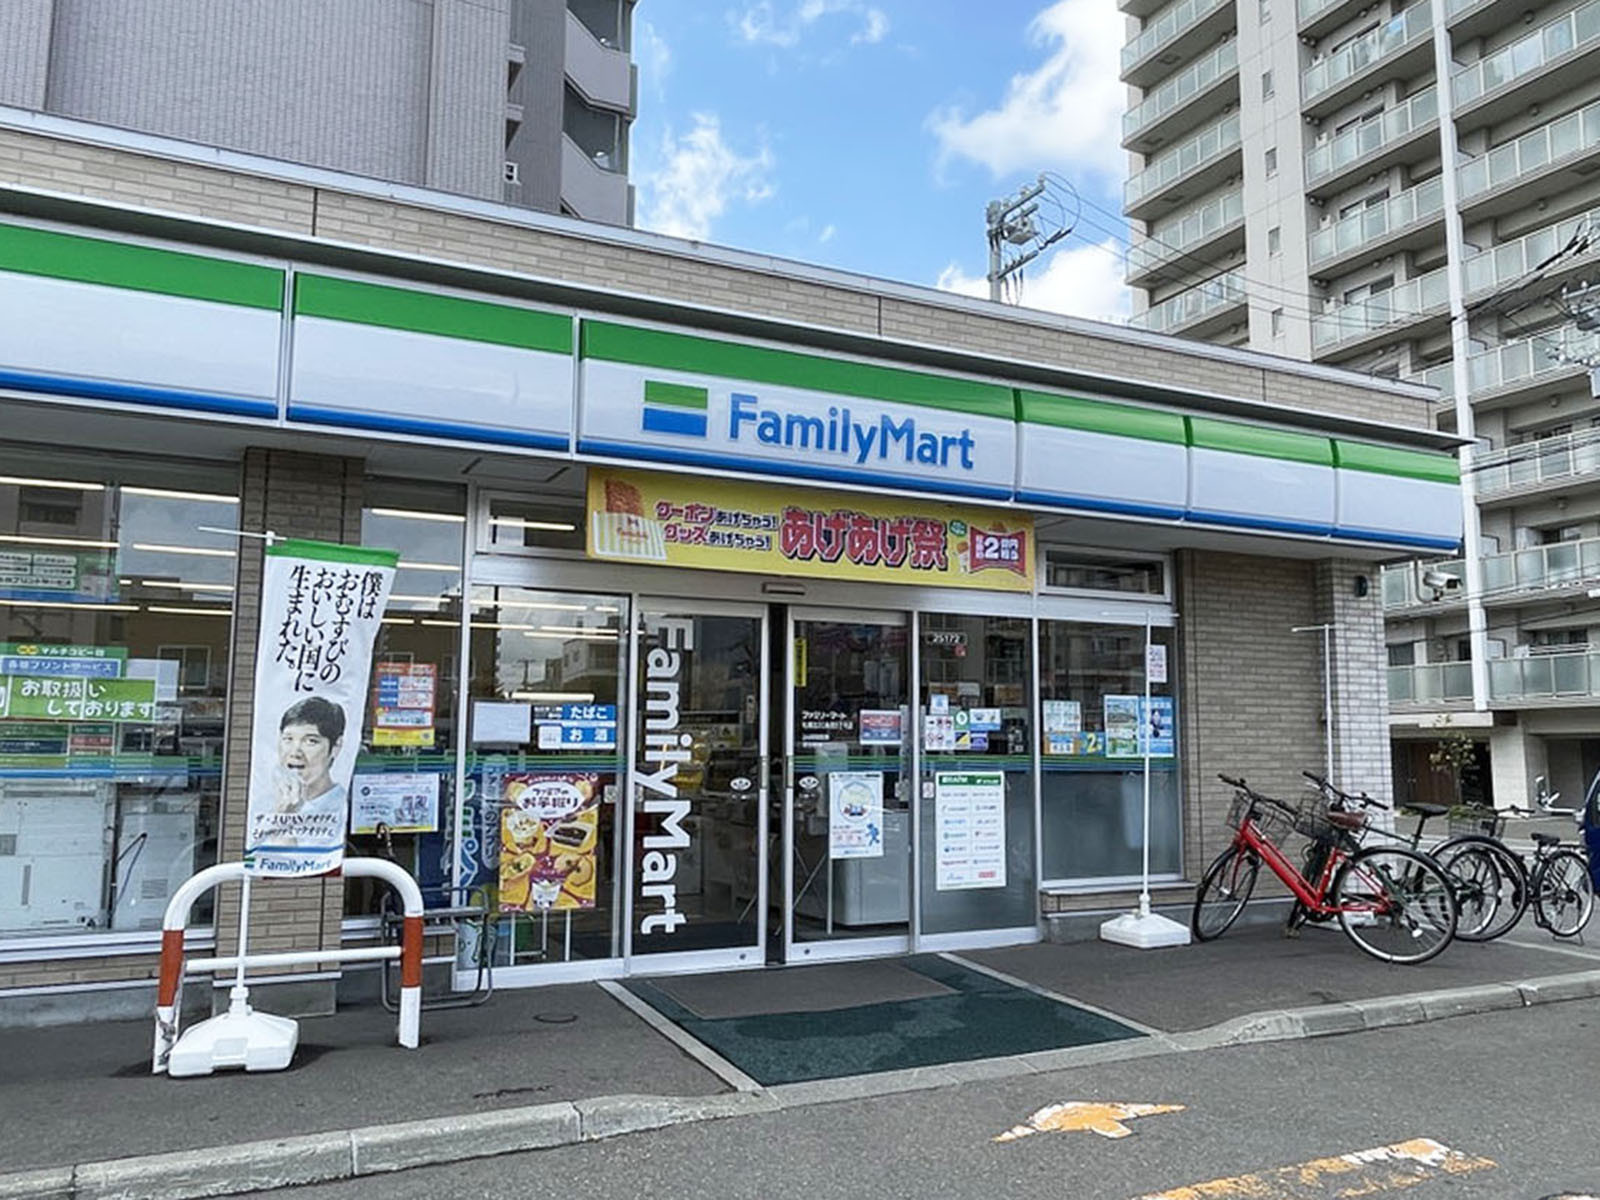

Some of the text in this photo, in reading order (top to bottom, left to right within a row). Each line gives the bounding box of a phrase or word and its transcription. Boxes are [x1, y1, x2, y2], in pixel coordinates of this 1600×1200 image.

[729, 392, 976, 471] FamilyMart
[780, 505, 949, 570] あげあげ祭
[276, 565, 311, 669] 生まれた。
[320, 569, 360, 685] おむすびの
[358, 571, 383, 619] 僕は
[295, 567, 337, 692] おいしい国に
[21, 680, 107, 698] お取扱い
[47, 699, 154, 718] しております
[570, 706, 608, 720] たばこ
[632, 618, 695, 936] FamilyMart
[260, 859, 331, 873] FamilyMart
